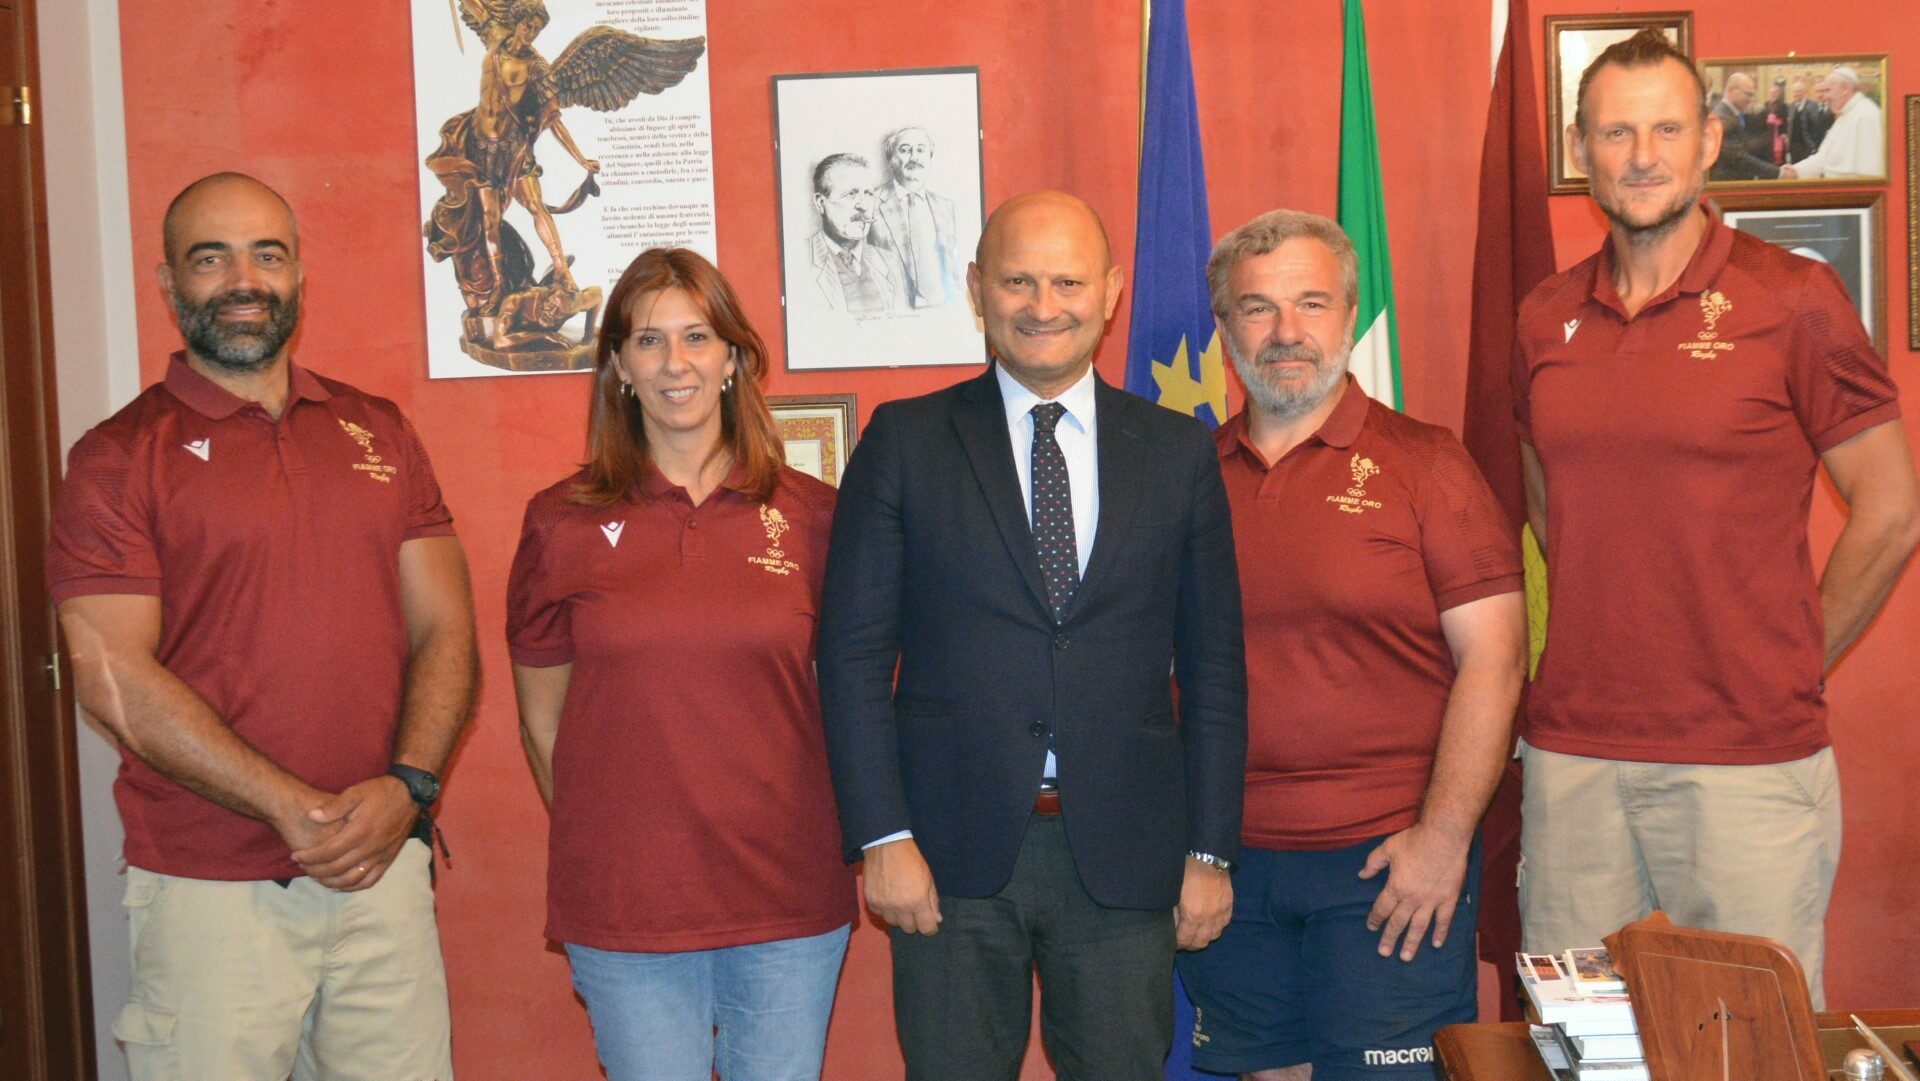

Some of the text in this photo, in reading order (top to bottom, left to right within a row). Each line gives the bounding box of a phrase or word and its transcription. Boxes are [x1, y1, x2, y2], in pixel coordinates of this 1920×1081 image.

[661, 13, 700, 21] sollecitudine
[628, 115, 646, 123] avesti
[675, 113, 701, 121] compito
[609, 125, 637, 133] altissimo
[646, 124, 667, 132] fugare
[667, 123, 676, 131] gli
[677, 122, 697, 131] spiriti
[597, 135, 629, 143] tenebrosi,
[629, 133, 651, 141] nemici
[651, 132, 668, 140] della
[693, 130, 709, 138] della
[643, 141, 661, 149] rendi
[598, 153, 629, 161] reverenza
[635, 151, 651, 159] nella
[652, 150, 679, 158] adesione
[693, 148, 709, 157] legge
[605, 161, 616, 169] del
[616, 160, 643, 169] Signore,
[643, 159, 662, 168] quelli
[600, 170, 609, 178] ha
[610, 169, 640, 177] chiamato
[601, 179, 630, 187] cittadini,
[631, 178, 664, 186] concordia,
[622, 213, 647, 221] ardente
[654, 221, 671, 229] legge
[672, 220, 688, 229] degli
[688, 218, 711, 226] uomini
[639, 230, 675, 238] entusiasmo
[675, 229, 686, 237] per
[640, 240, 651, 248] per
[1713, 342, 1735, 351] ORO
[1326, 496, 1381, 508] FIAMME ORO
[748, 557, 799, 570] FIAMME ORO
